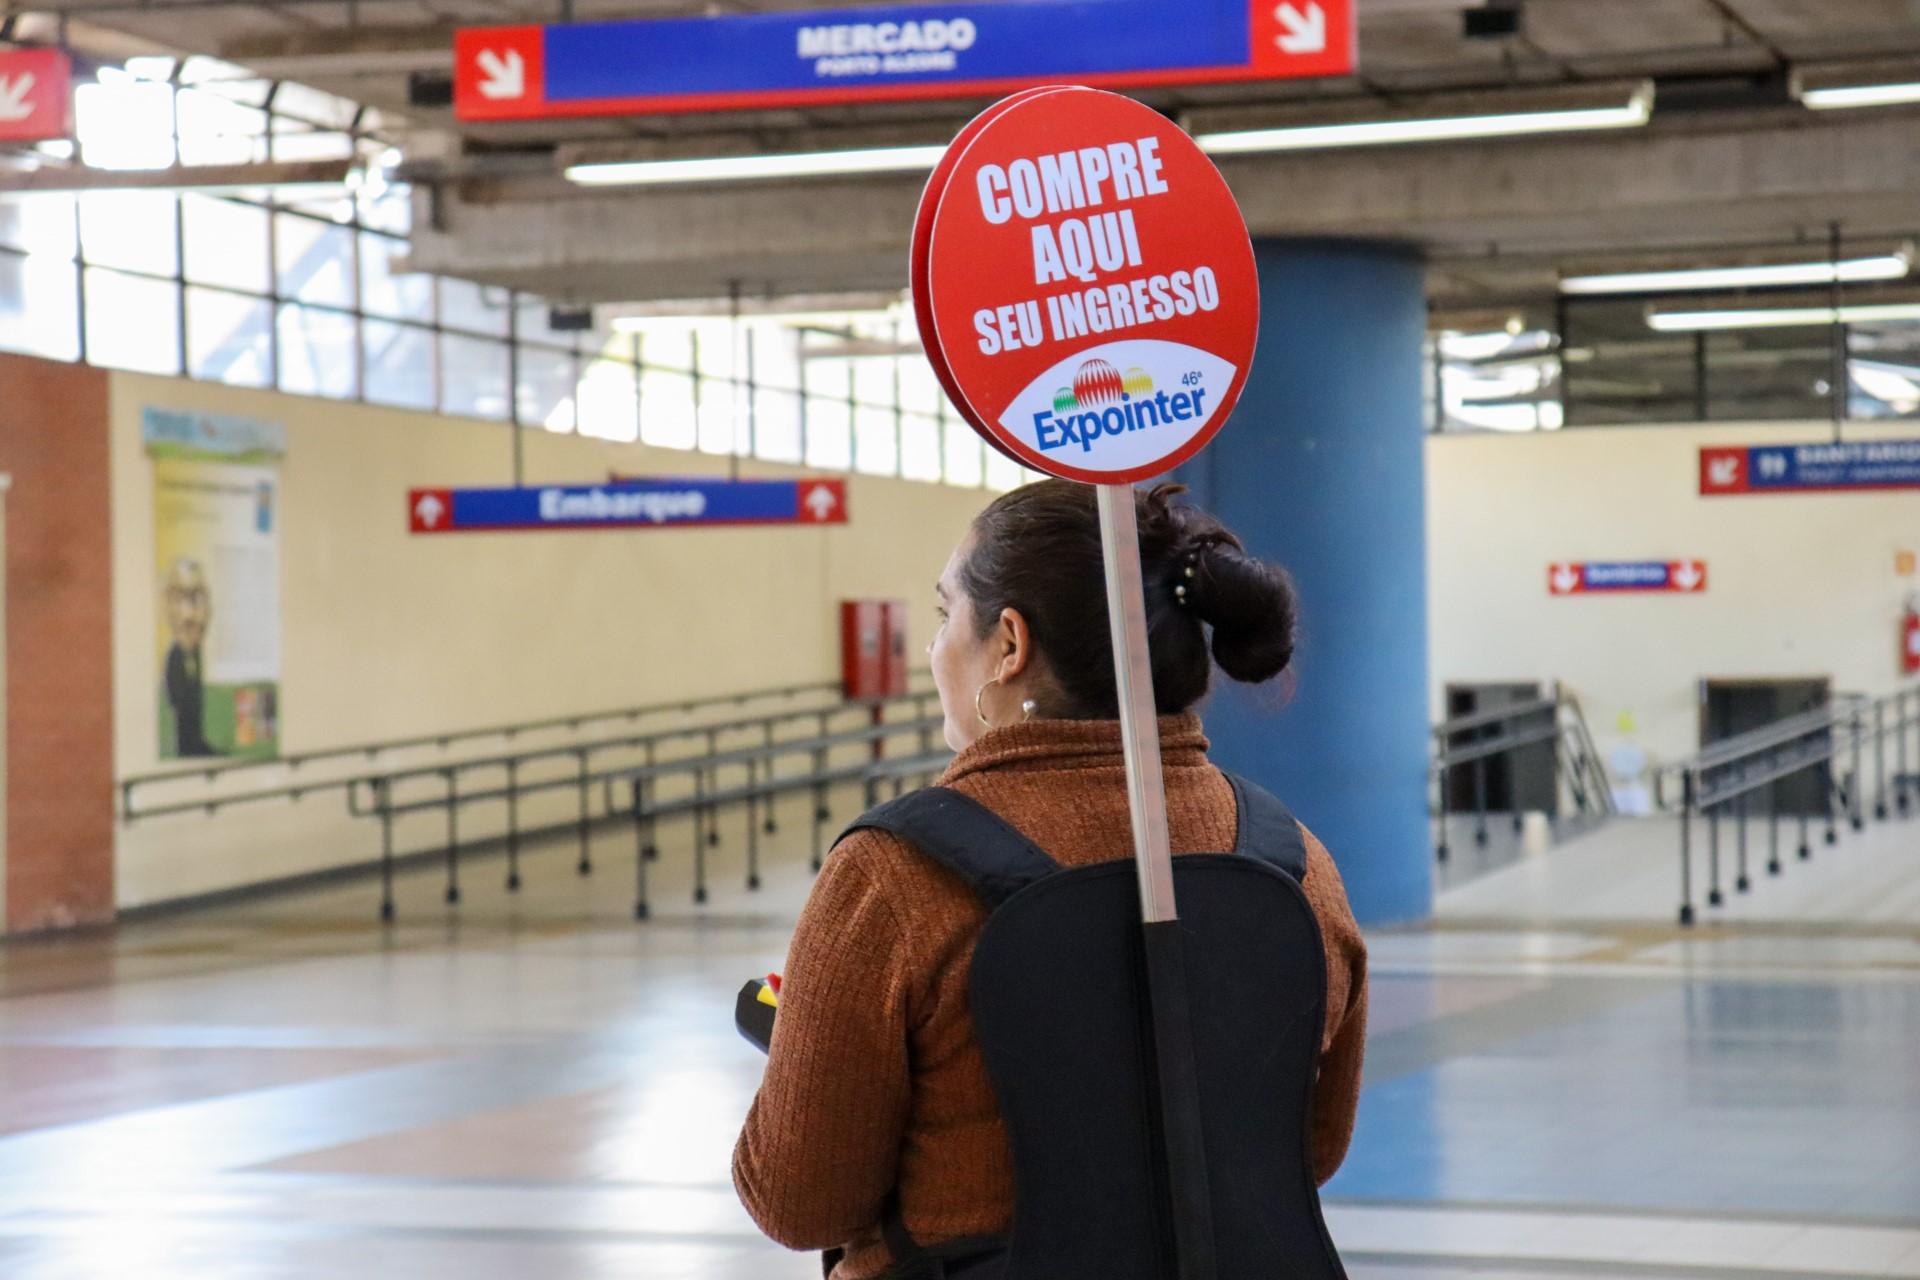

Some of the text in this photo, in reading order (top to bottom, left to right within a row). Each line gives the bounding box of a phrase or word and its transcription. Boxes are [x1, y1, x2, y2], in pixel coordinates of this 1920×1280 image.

[797, 18, 976, 59] MERCADO
[815, 51, 957, 77] PORTO ALEGRE
[976, 137, 1168, 224] COMPRE
[1031, 209, 1142, 284] AQUI
[973, 266, 1220, 356] SEU INGRESSO
[1033, 388, 1206, 452] Expointer
[539, 487, 706, 524] Embarque
